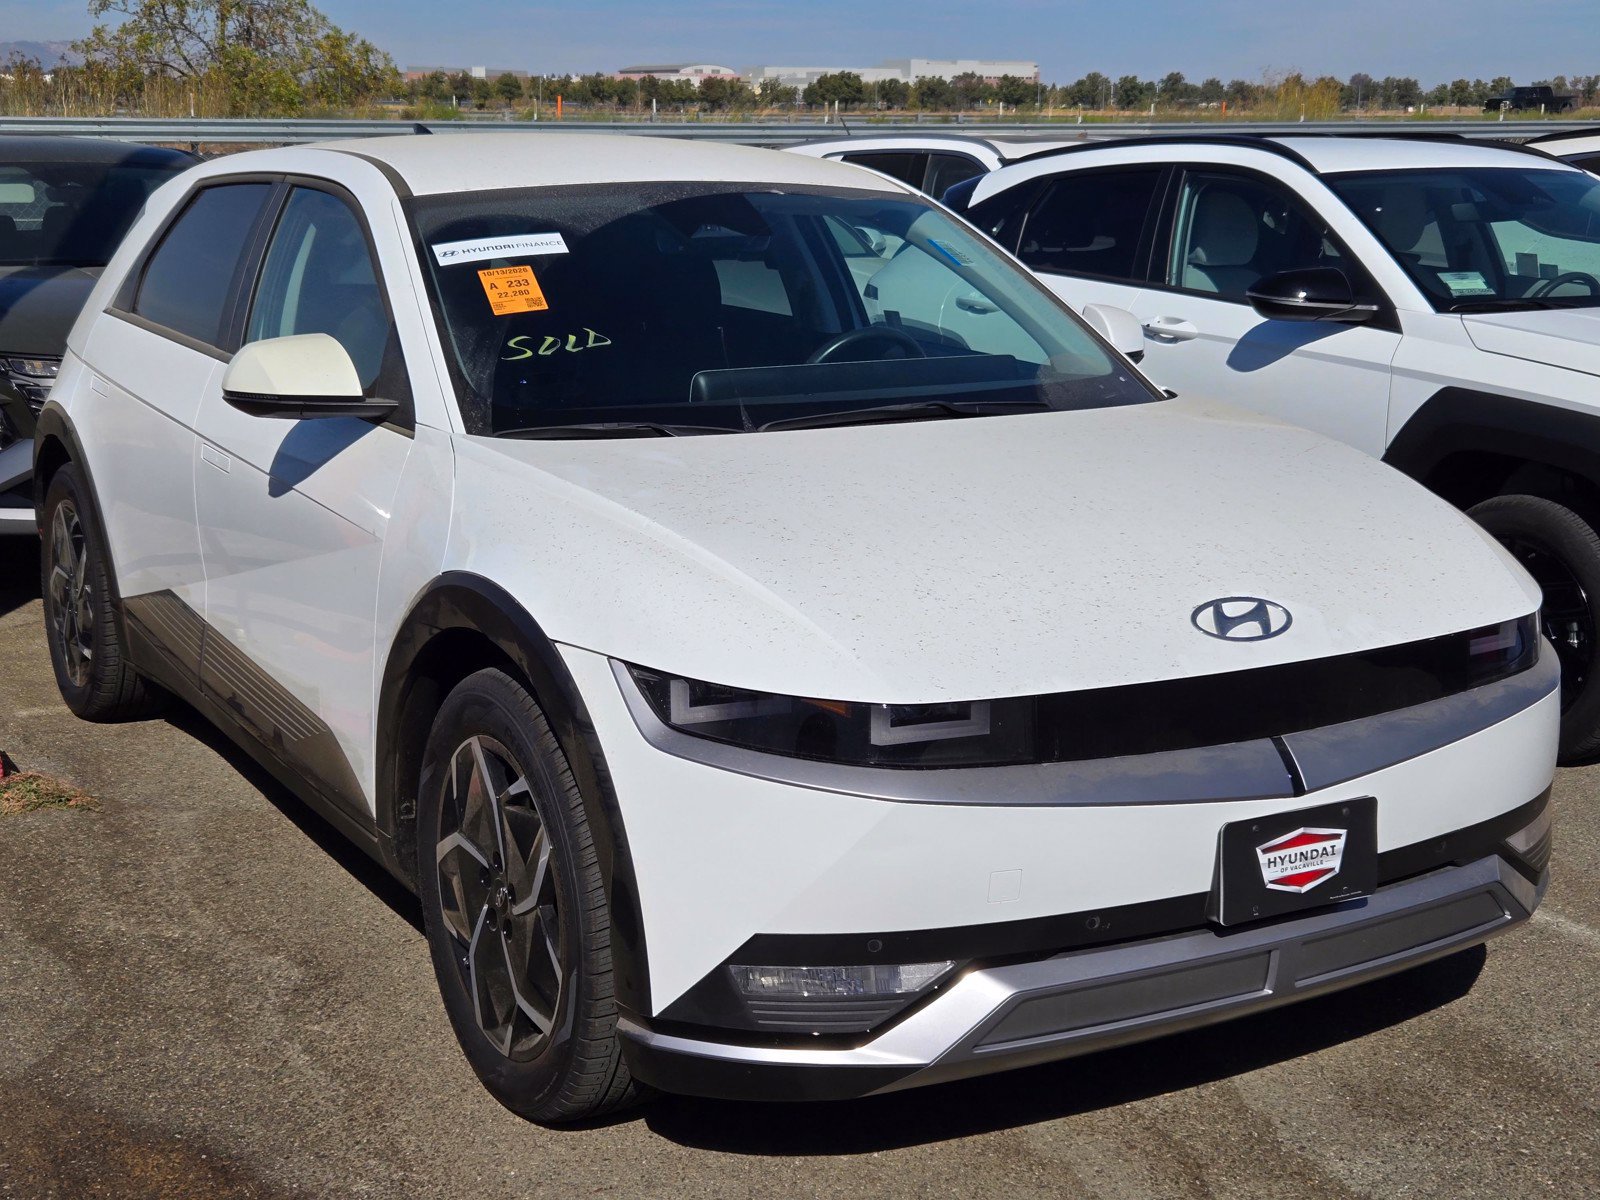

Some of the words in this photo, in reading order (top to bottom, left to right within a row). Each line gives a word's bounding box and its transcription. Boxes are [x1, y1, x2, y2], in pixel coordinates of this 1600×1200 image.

[482, 267, 528, 277] 10/13/2026
[489, 282, 499, 290] A
[506, 278, 530, 288] 233
[501, 327, 612, 360] SOLD
[1267, 844, 1337, 869] HYUNDAI
[1290, 859, 1324, 871] VACAVILLE
